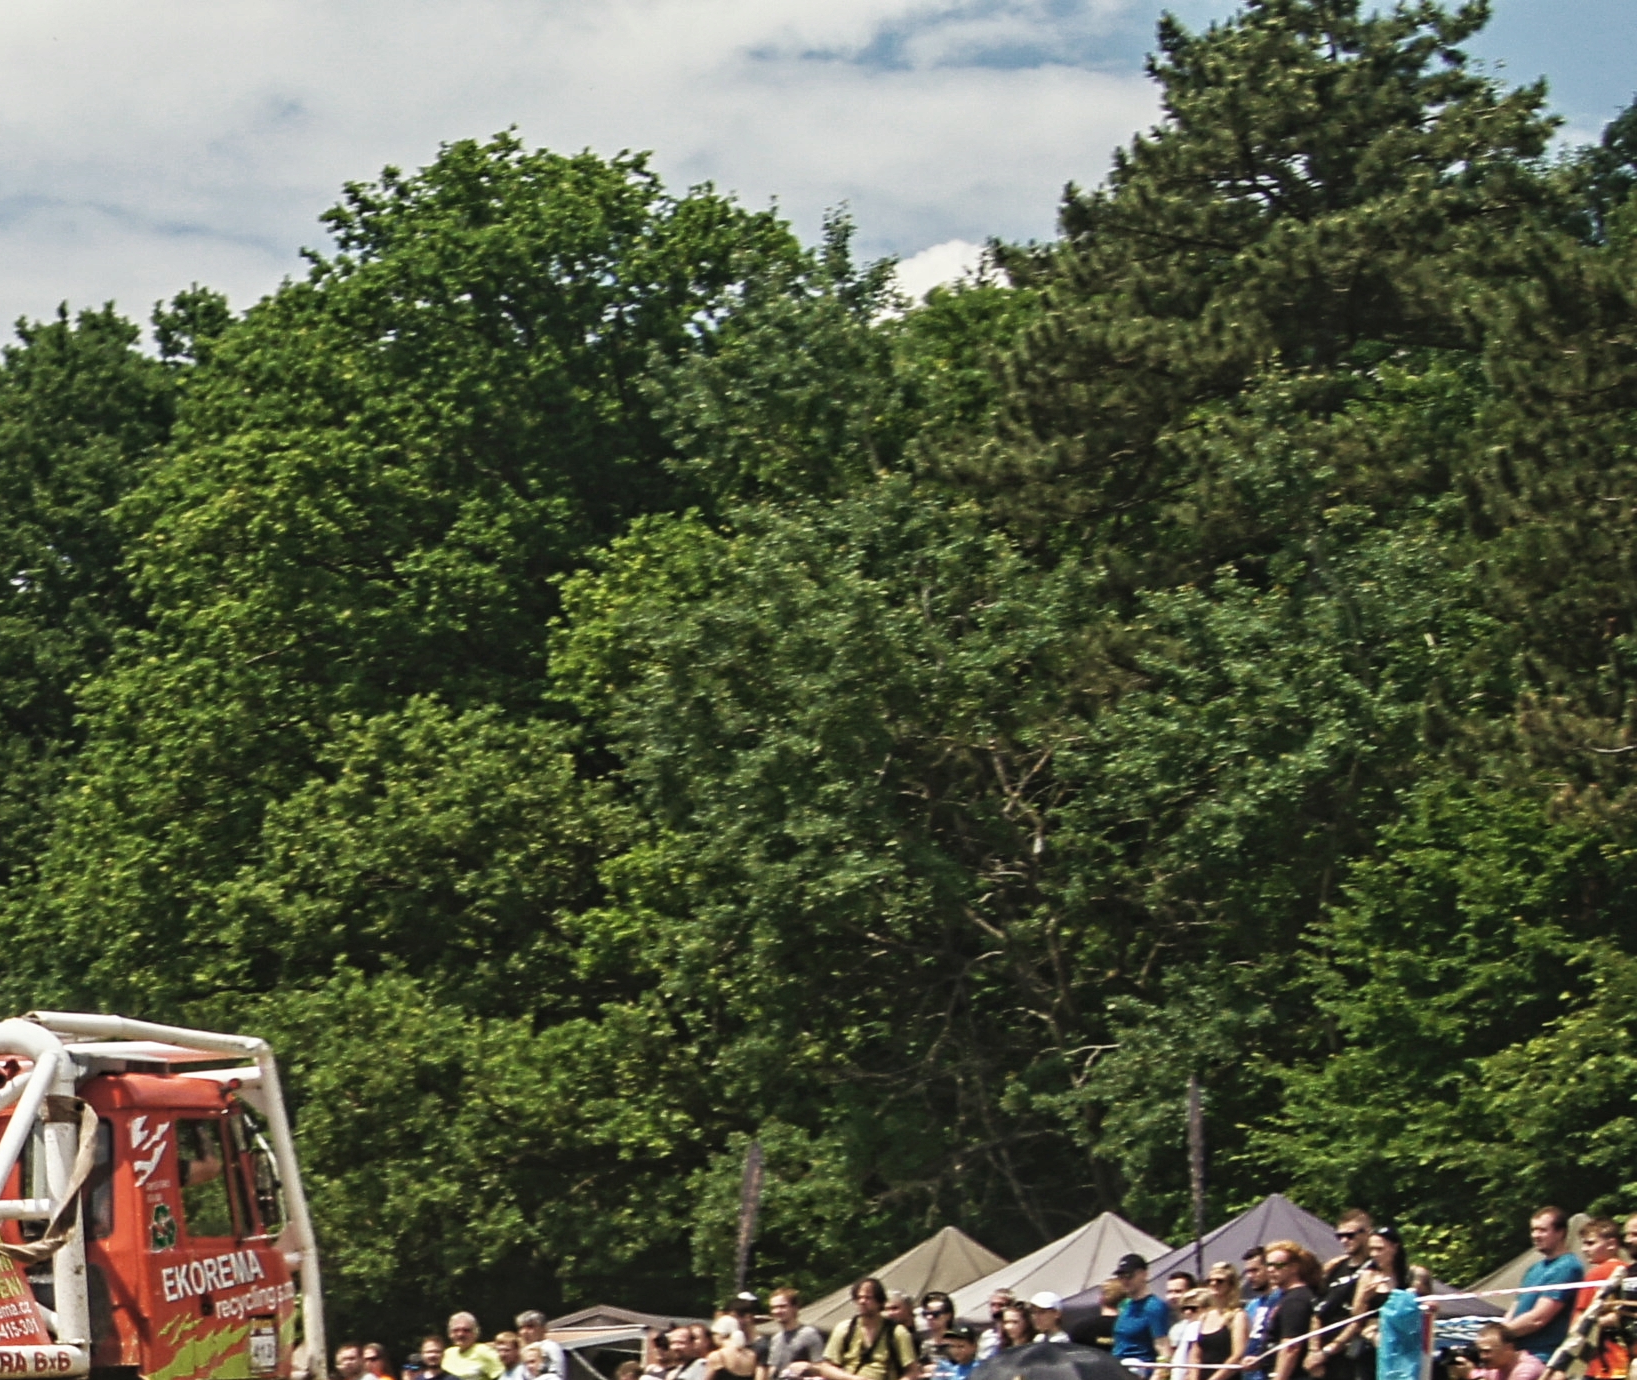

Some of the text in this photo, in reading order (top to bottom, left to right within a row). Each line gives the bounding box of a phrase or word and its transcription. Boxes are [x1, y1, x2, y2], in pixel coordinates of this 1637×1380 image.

[161, 1250, 265, 1302] EKOREMA
[214, 1284, 276, 1320] recycling
[33, 1350, 72, 1373] 6x6
